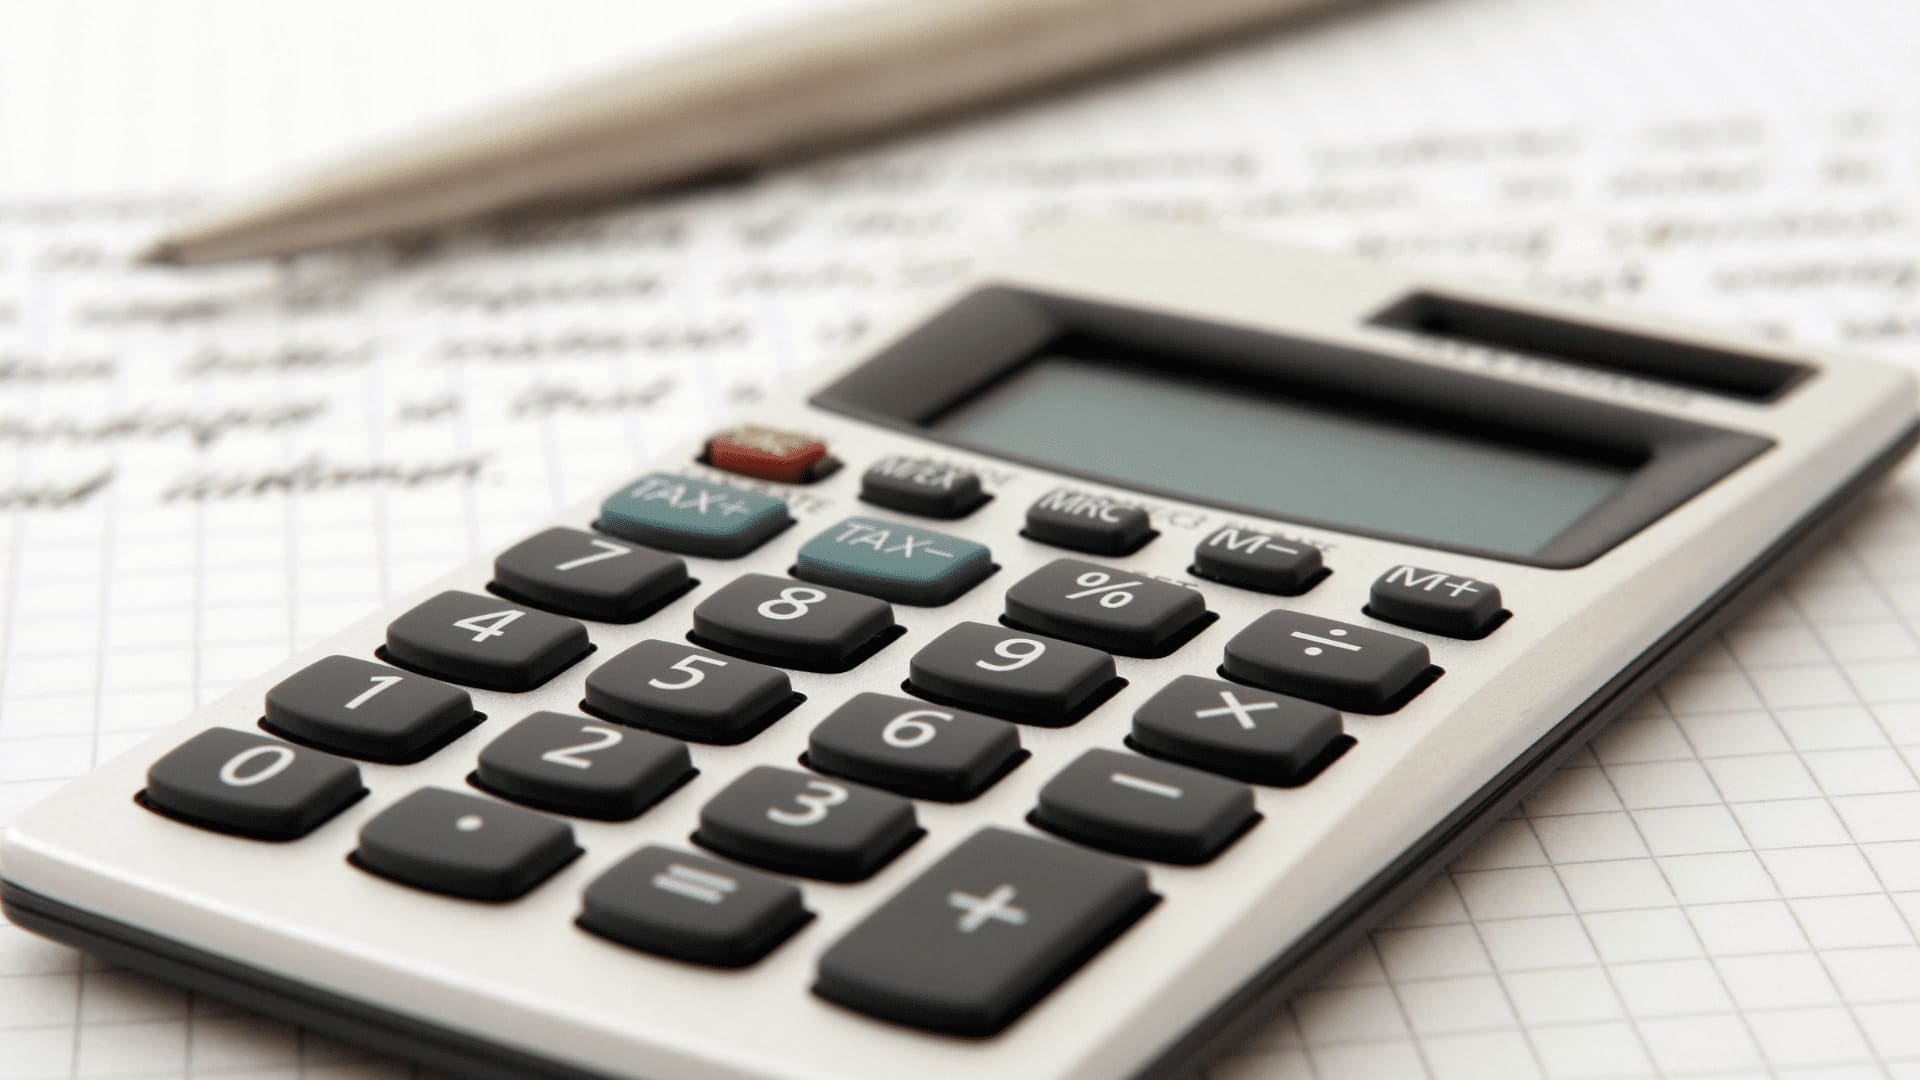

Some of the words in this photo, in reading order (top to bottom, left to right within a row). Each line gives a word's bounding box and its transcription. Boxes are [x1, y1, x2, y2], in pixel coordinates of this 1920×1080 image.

[1040, 487, 1130, 523] MRC
[556, 538, 632, 570] 7
[1064, 571, 1143, 609] %
[1385, 565, 1480, 599] M+
[757, 586, 827, 620] 8
[453, 609, 526, 643] 4
[648, 654, 728, 690] 5
[977, 637, 1047, 672] 9
[344, 675, 404, 710] 1
[541, 725, 626, 768] 2
[881, 709, 955, 748] 6
[219, 744, 297, 786] 0
[767, 780, 849, 825] 3
[653, 862, 738, 904] =
[950, 884, 1026, 932] +
